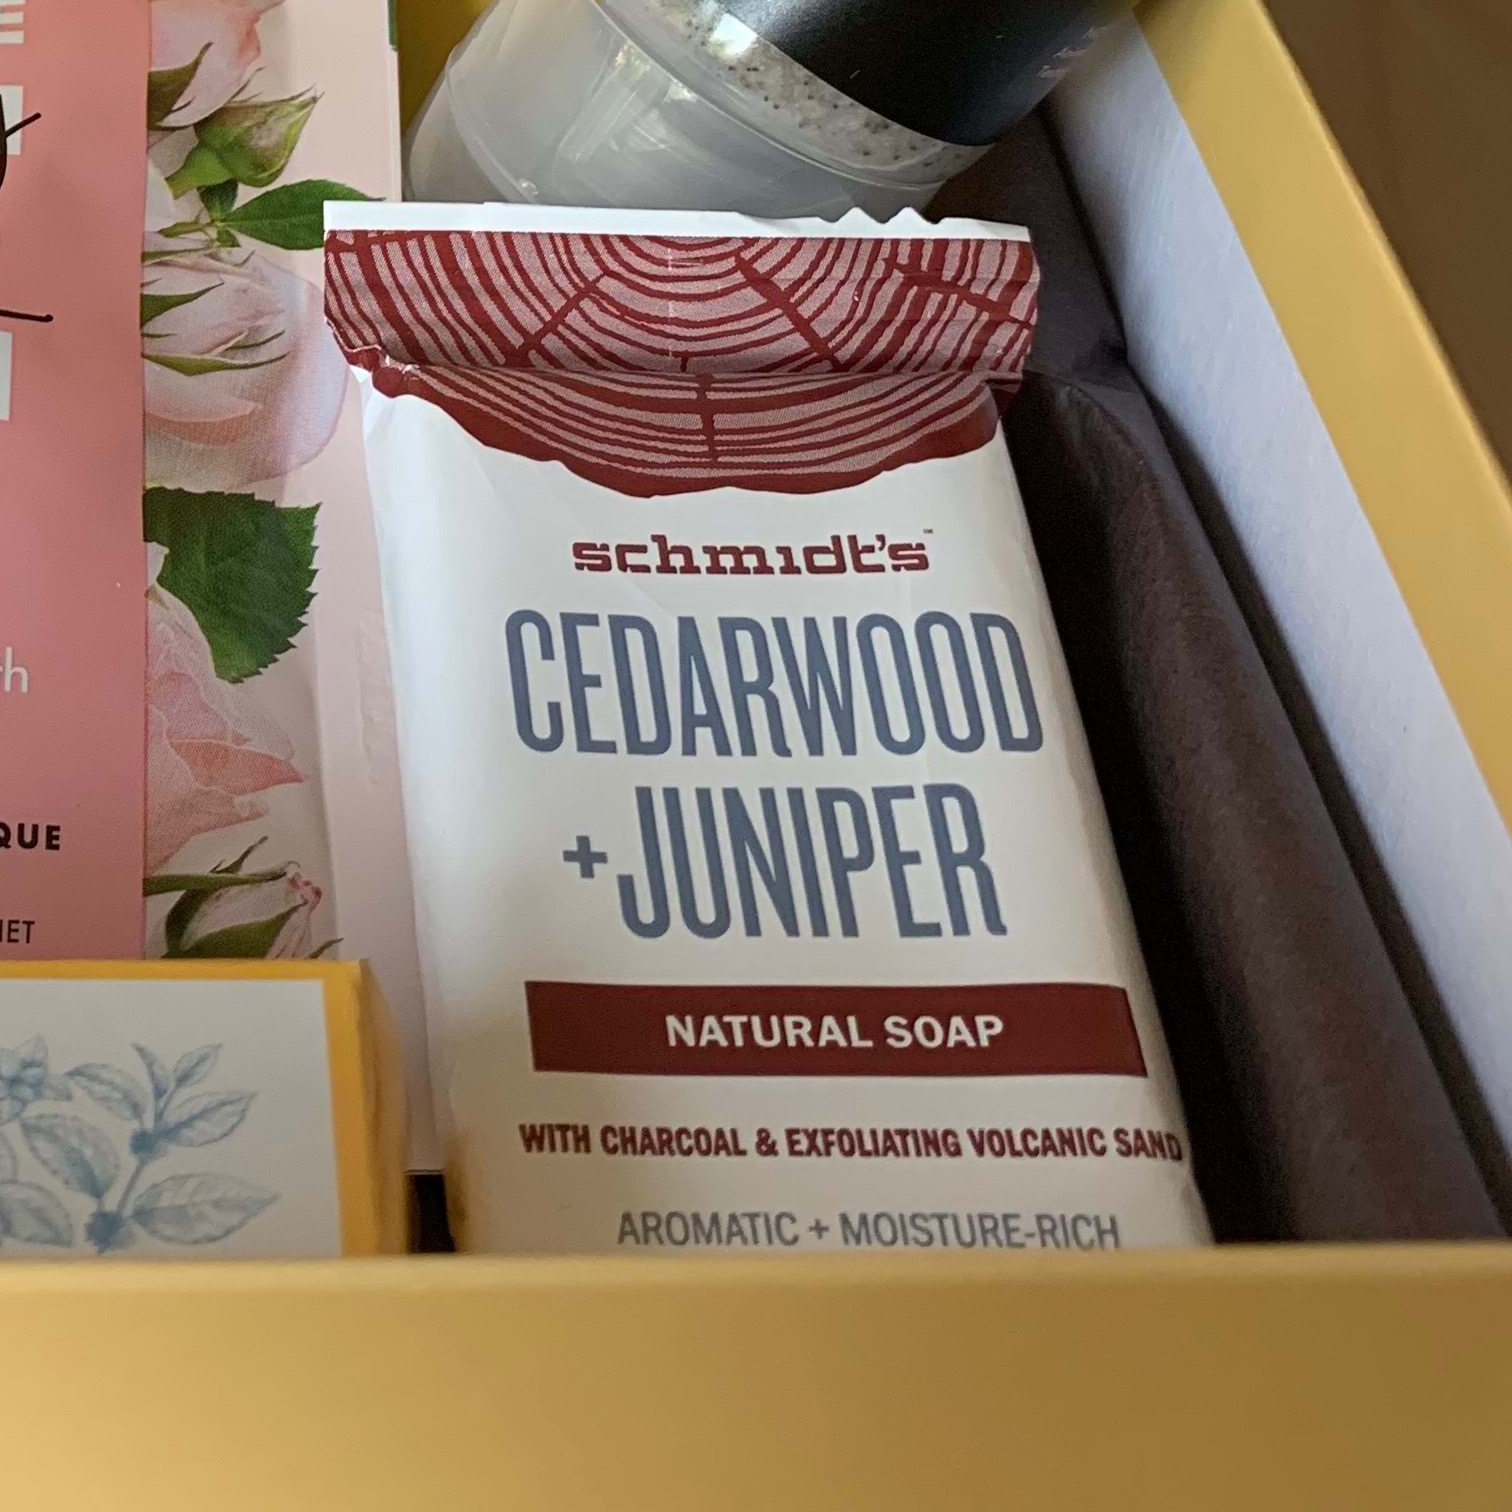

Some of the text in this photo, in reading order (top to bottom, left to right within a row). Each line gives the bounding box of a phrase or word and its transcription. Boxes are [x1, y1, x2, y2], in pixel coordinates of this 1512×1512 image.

[505, 609, 1043, 758] CEDARWOOD
[665, 1014, 1004, 1049] NATURAL SOAP
[519, 1122, 1183, 1162] WITH CHARCOAL & EXFOLIATING VOLCANIC SAND
[617, 1210, 800, 1247] AROMATIC
[839, 1212, 1122, 1251] MOISTURE-RICH
